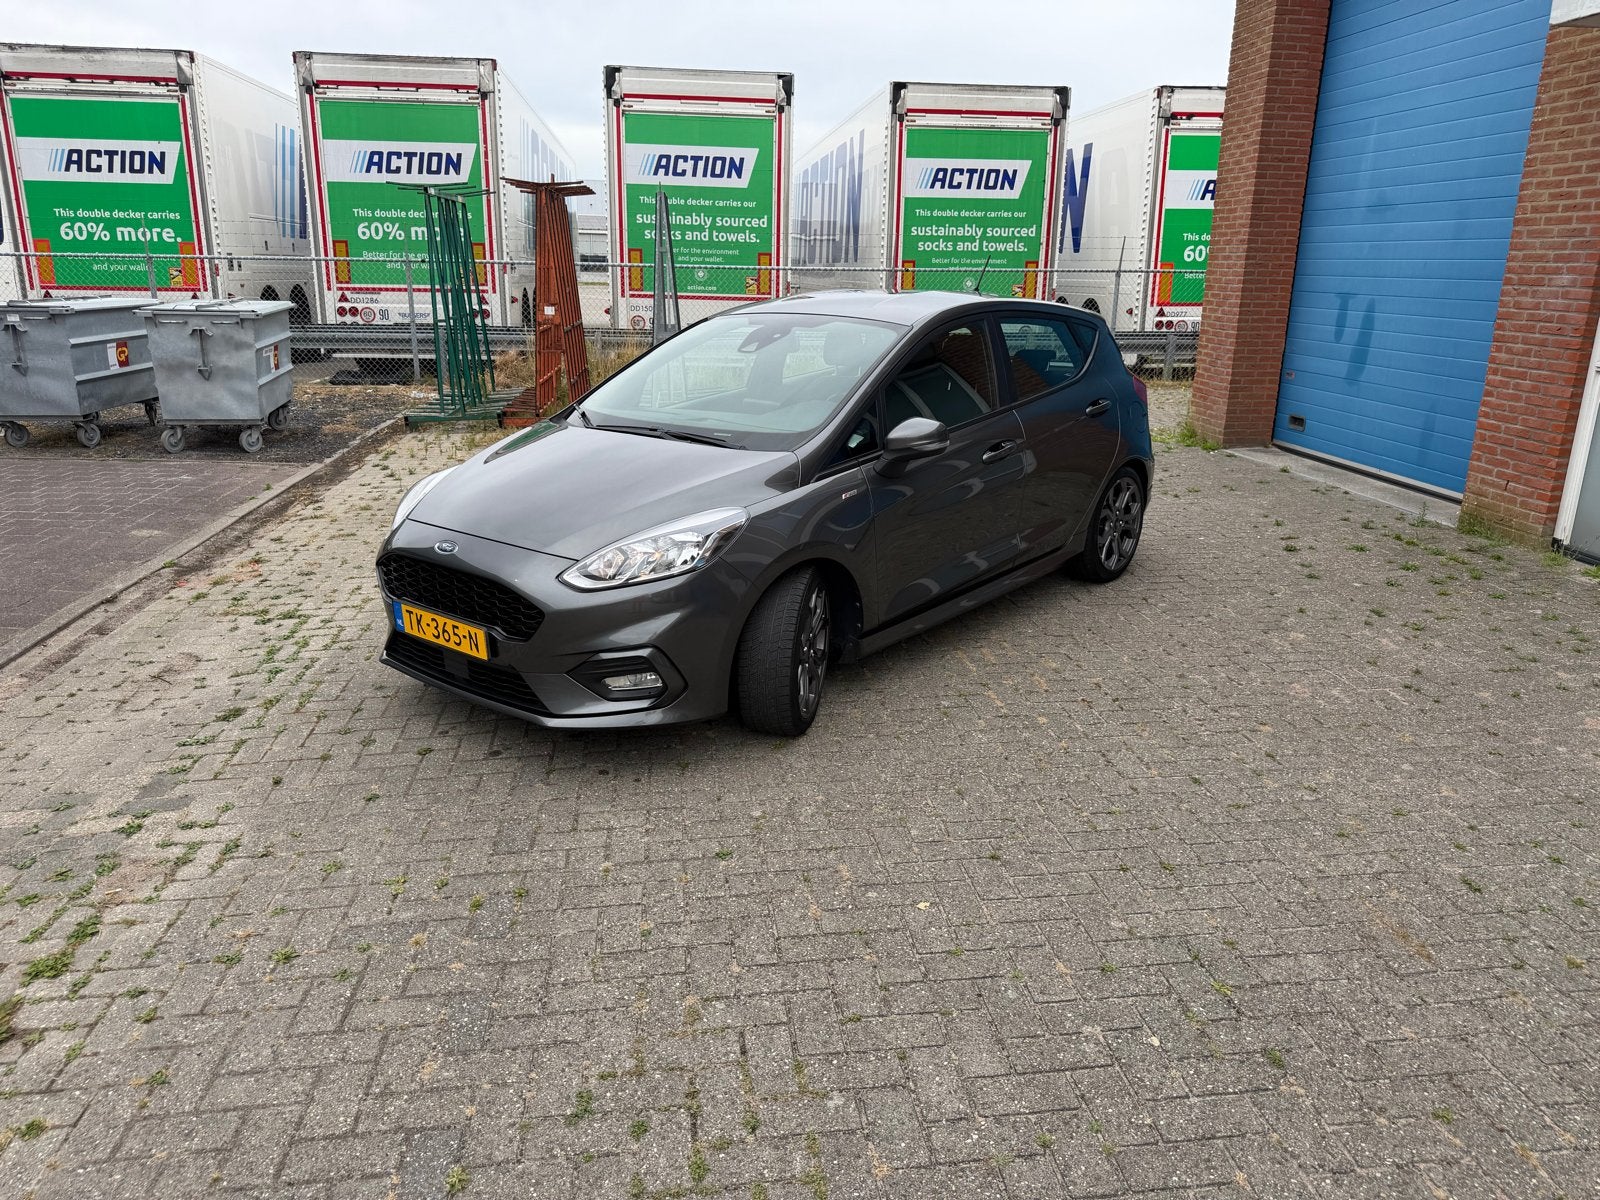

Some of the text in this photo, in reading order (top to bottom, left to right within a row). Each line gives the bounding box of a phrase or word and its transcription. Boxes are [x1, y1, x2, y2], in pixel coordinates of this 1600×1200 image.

[64, 148, 166, 175] ACTION
[365, 150, 463, 176] ACTION
[653, 154, 745, 179] ACTION
[929, 167, 1018, 190] ACTION
[640, 196, 656, 204] This
[687, 198, 713, 207] decker
[715, 199, 741, 208] carries
[53, 208, 181, 220] This double decker carries
[353, 208, 372, 218] This
[374, 209, 406, 218] double
[636, 211, 768, 228] susinably sourced
[915, 209, 931, 217] This
[932, 209, 959, 217] double
[960, 209, 985, 218] decker
[987, 209, 1012, 218] carries
[60, 221, 182, 243] 60% more.
[357, 221, 405, 240] 60%
[685, 229, 709, 242] and
[712, 230, 760, 243] towels.
[911, 224, 1037, 239] sustainably sourced
[1183, 232, 1200, 241] This
[702, 248, 740, 256] environment
[917, 239, 1028, 252] socks and towels.
[1183, 245, 1210, 262] 60
[950, 257, 960, 265] for
[92, 263, 108, 271] and
[110, 263, 128, 273] your
[687, 284, 718, 292] action.com
[378, 308, 390, 321] 90
[405, 608, 480, 654] TK-365-N
